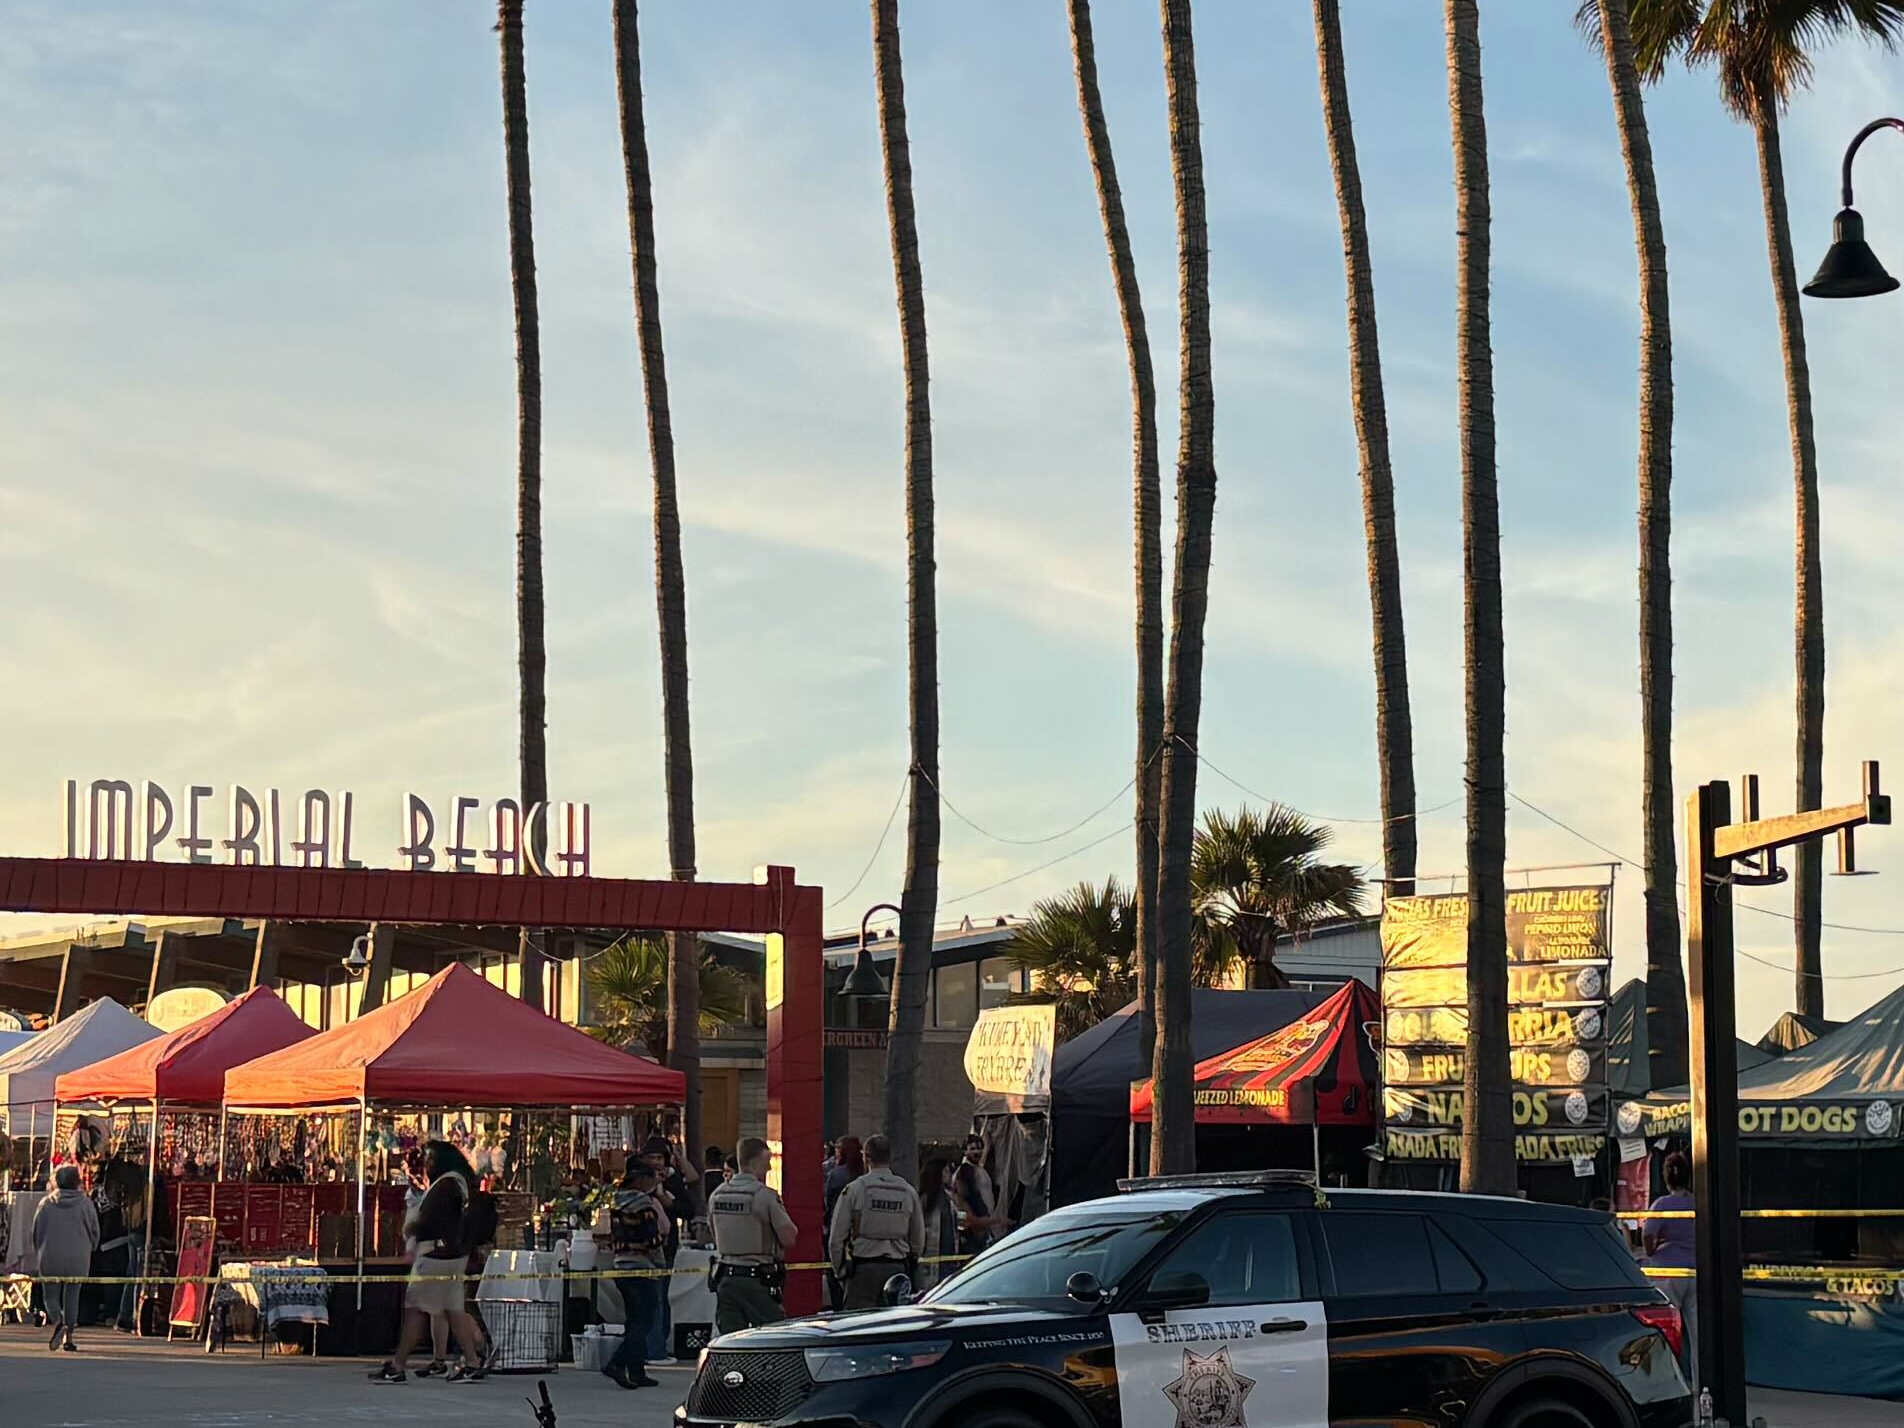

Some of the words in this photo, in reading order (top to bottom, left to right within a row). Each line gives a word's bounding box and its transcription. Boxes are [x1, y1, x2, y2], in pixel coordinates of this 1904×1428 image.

[63, 779, 363, 868] IMPERIAL
[398, 792, 590, 877] BEACH
[1507, 891, 1553, 913] FRUIT
[1553, 890, 1607, 912] JUICES
[1229, 1090, 1285, 1106] LEMONADE
[1781, 1106, 1856, 1133] DOGS
[1387, 1135, 1438, 1159] ASADA
[1146, 1320, 1256, 1343] SHERIFF
